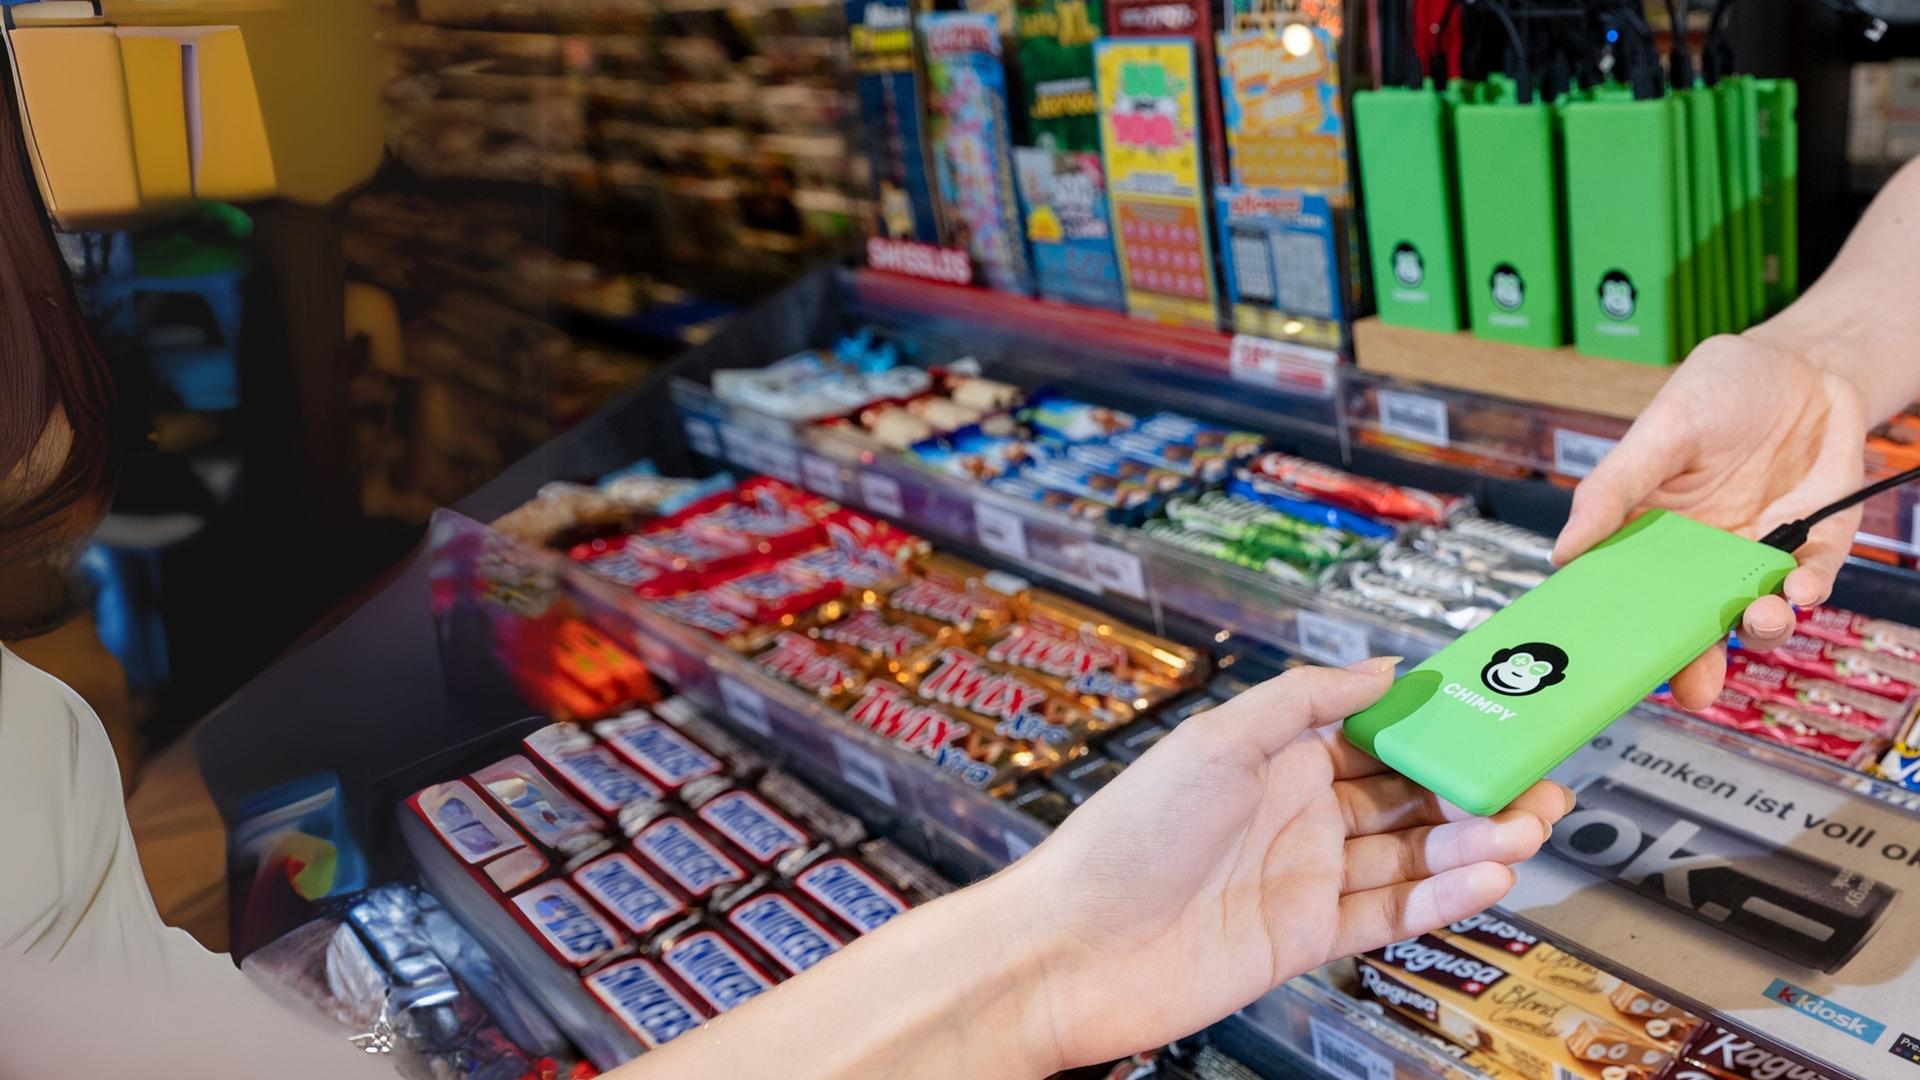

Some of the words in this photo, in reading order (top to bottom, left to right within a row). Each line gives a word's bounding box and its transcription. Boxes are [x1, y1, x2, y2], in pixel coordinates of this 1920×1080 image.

[918, 647, 1047, 720] TWIX
[1443, 683, 1517, 722] CHIMPY
[846, 678, 971, 758] TWIX
[1620, 743, 1739, 799] tanken
[1744, 789, 1795, 820] ist
[1803, 813, 1877, 849] voll
[1358, 964, 1438, 1015] Ragusa
[1796, 994, 1870, 1036] kiosk
